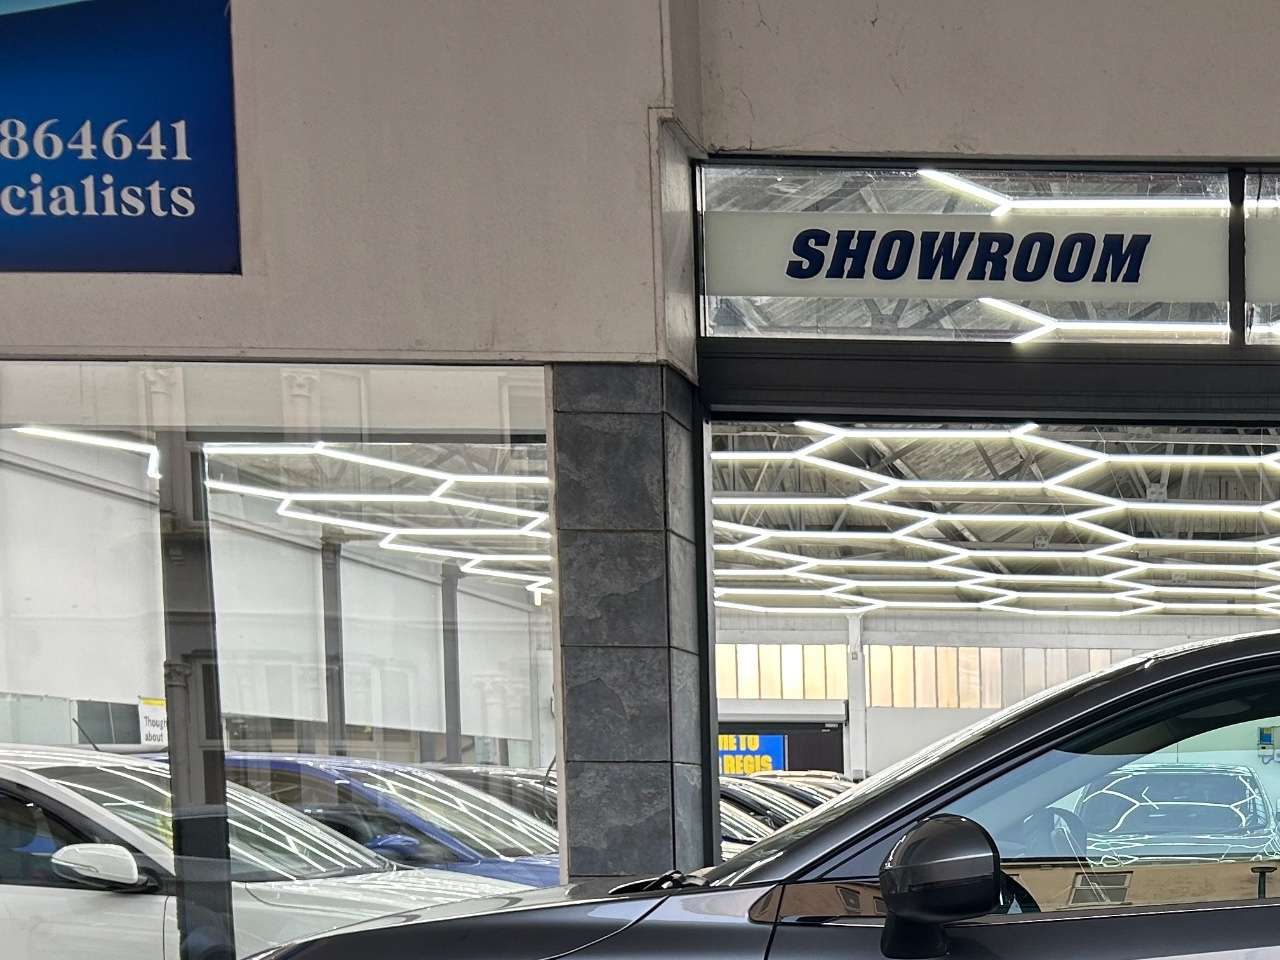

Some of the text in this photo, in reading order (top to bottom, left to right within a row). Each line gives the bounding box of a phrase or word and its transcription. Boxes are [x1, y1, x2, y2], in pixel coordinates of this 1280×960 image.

[0, 118, 192, 160] 864641
[0, 173, 195, 217] cialists
[785, 228, 1152, 283] SHOWROOM
[145, 732, 163, 742] about
[723, 754, 773, 775] REGIS
